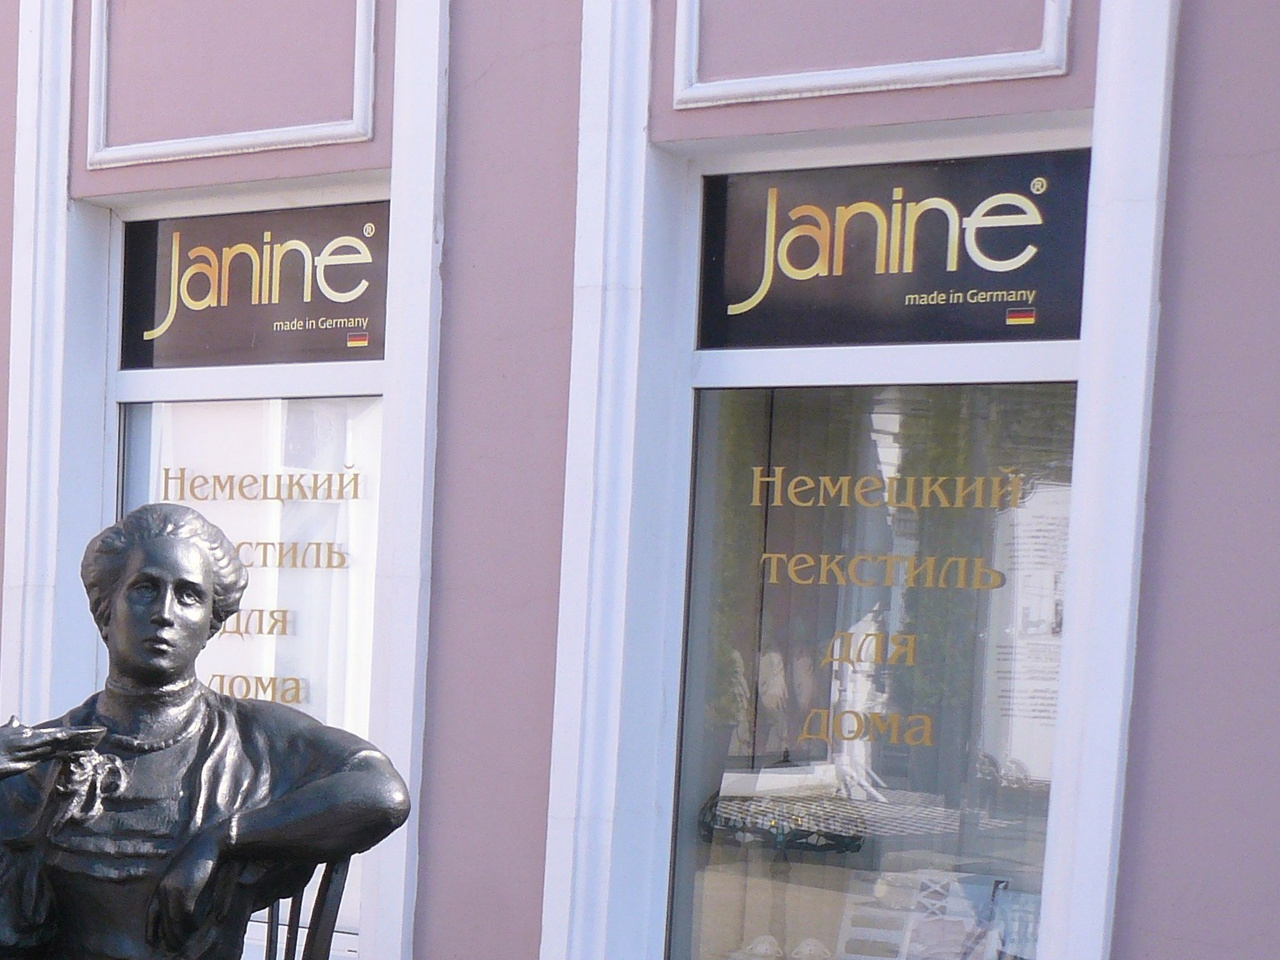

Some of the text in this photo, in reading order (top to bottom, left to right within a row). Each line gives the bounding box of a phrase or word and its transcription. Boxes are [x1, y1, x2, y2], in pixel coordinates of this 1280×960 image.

[905, 289, 1036, 305] made in Germany
[273, 317, 369, 331] made in Germany
[161, 463, 361, 504] Немецкий
[749, 465, 1024, 512] Немецкий
[235, 541, 347, 569] стиль
[759, 552, 1007, 590] текстиль
[821, 630, 918, 674] для
[797, 708, 933, 747] дома
